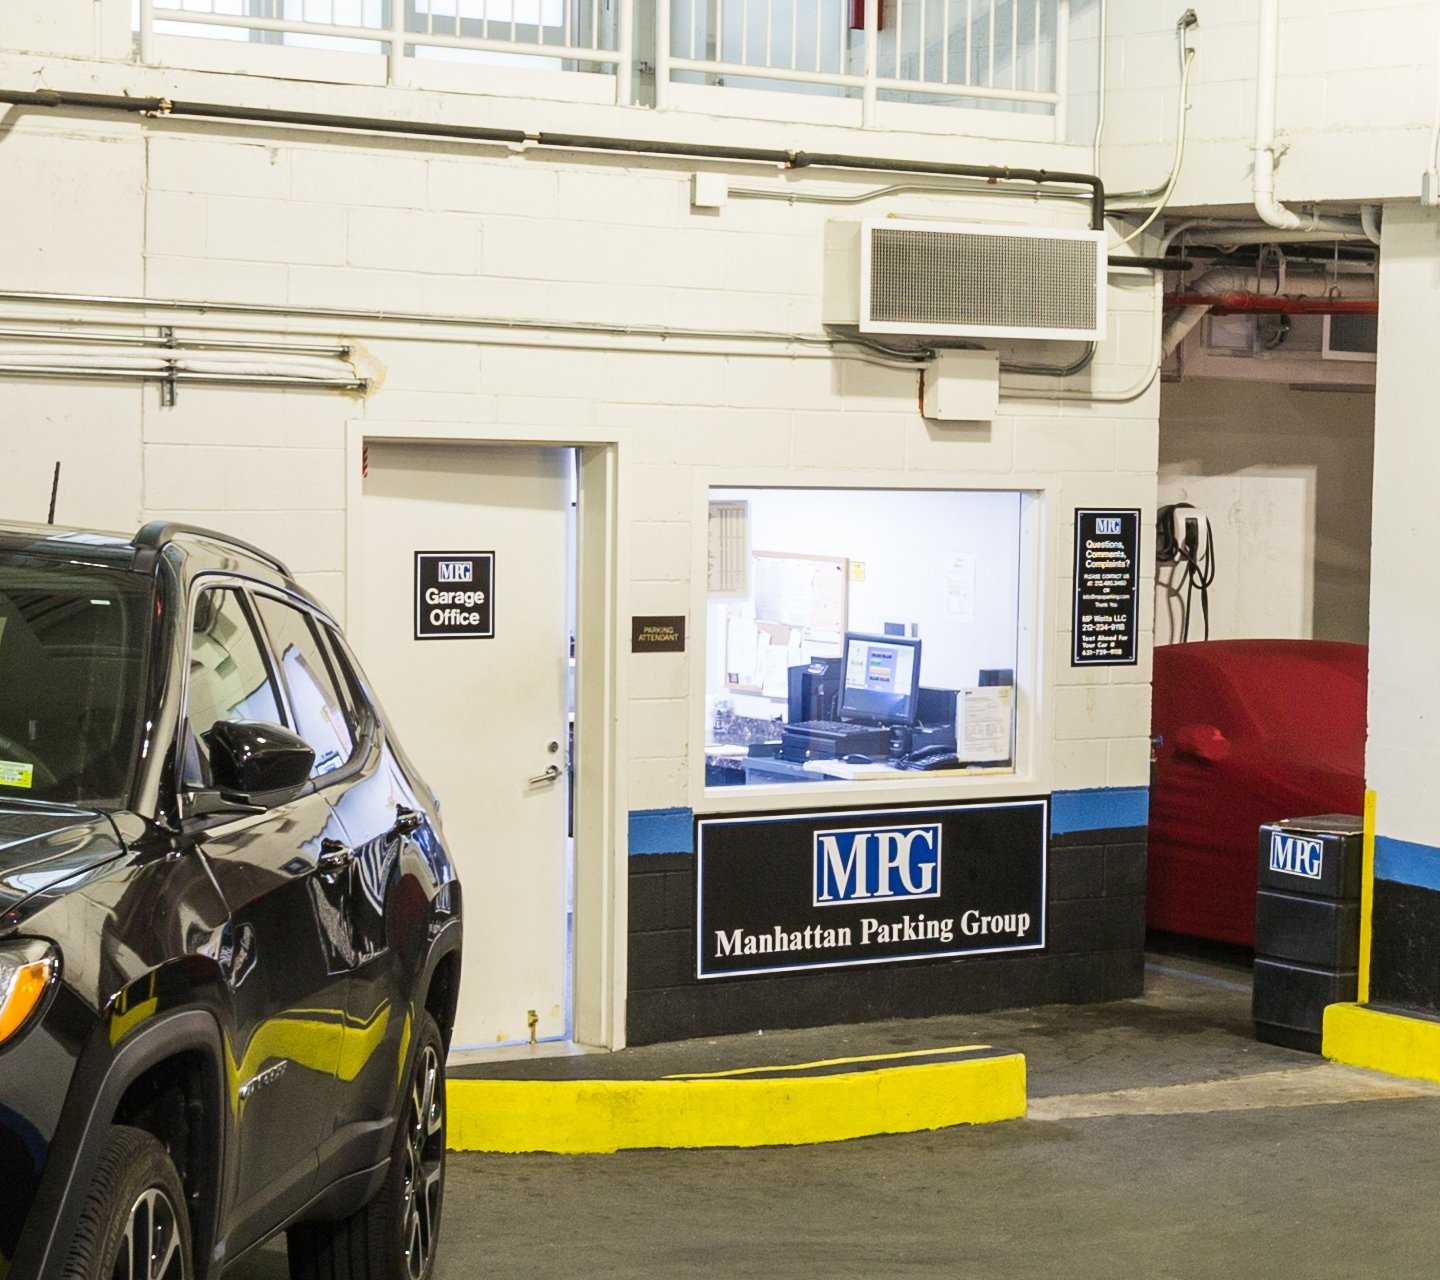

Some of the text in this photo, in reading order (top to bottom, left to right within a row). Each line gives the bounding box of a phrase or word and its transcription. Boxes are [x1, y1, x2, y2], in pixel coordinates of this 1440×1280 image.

[1085, 539, 1125, 549] Questions,
[441, 563, 471, 580] MPG
[425, 587, 485, 607] Garage
[430, 608, 480, 626] Office
[638, 633, 679, 641] ATTENDANT
[643, 625, 674, 633] PARKING
[1272, 835, 1321, 876] MPG
[818, 829, 936, 901] MPG
[714, 909, 1030, 958] Manhattan Parking Group
